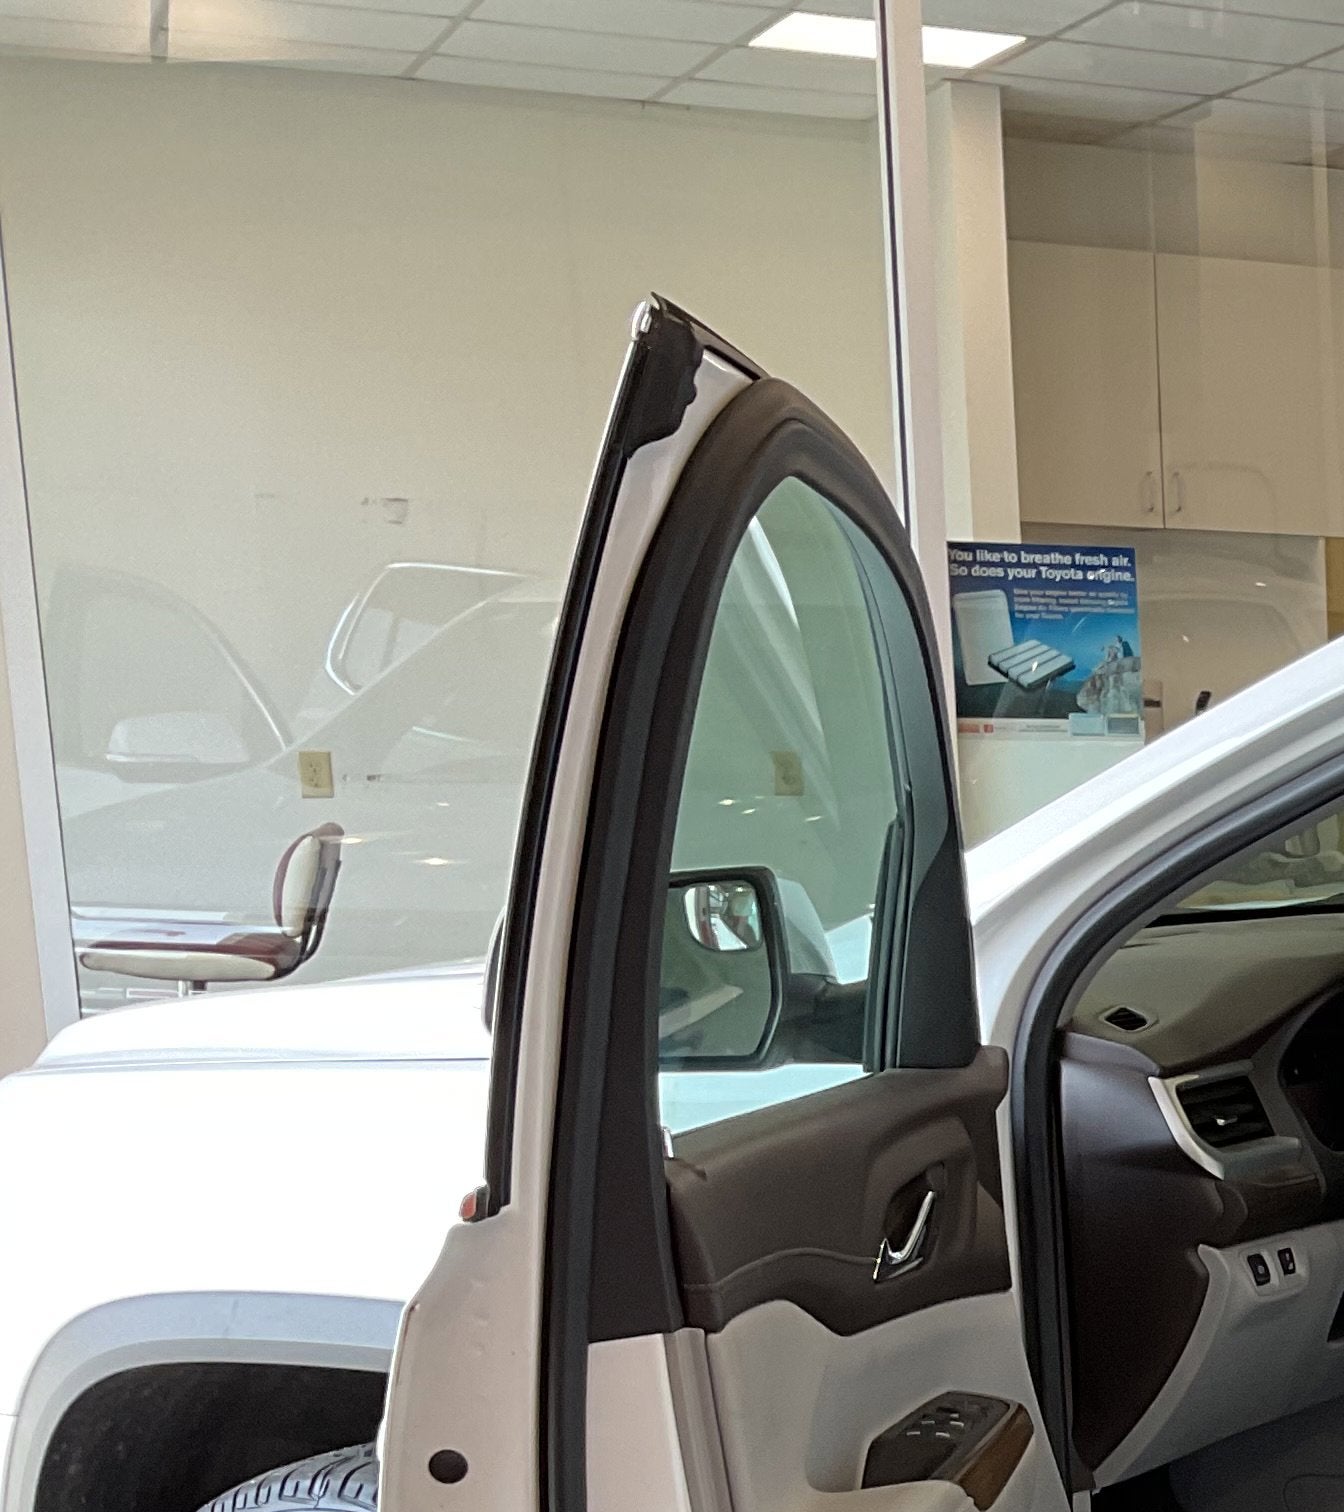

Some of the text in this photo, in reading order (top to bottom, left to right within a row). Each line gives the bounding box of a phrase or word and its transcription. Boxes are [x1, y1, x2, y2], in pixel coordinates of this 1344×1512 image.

[948, 549, 1132, 567] You like to breathe fresh air.
[949, 563, 968, 576] So
[971, 564, 1005, 577] does
[1007, 567, 1037, 581] your
[1039, 565, 1083, 582] Toyota
